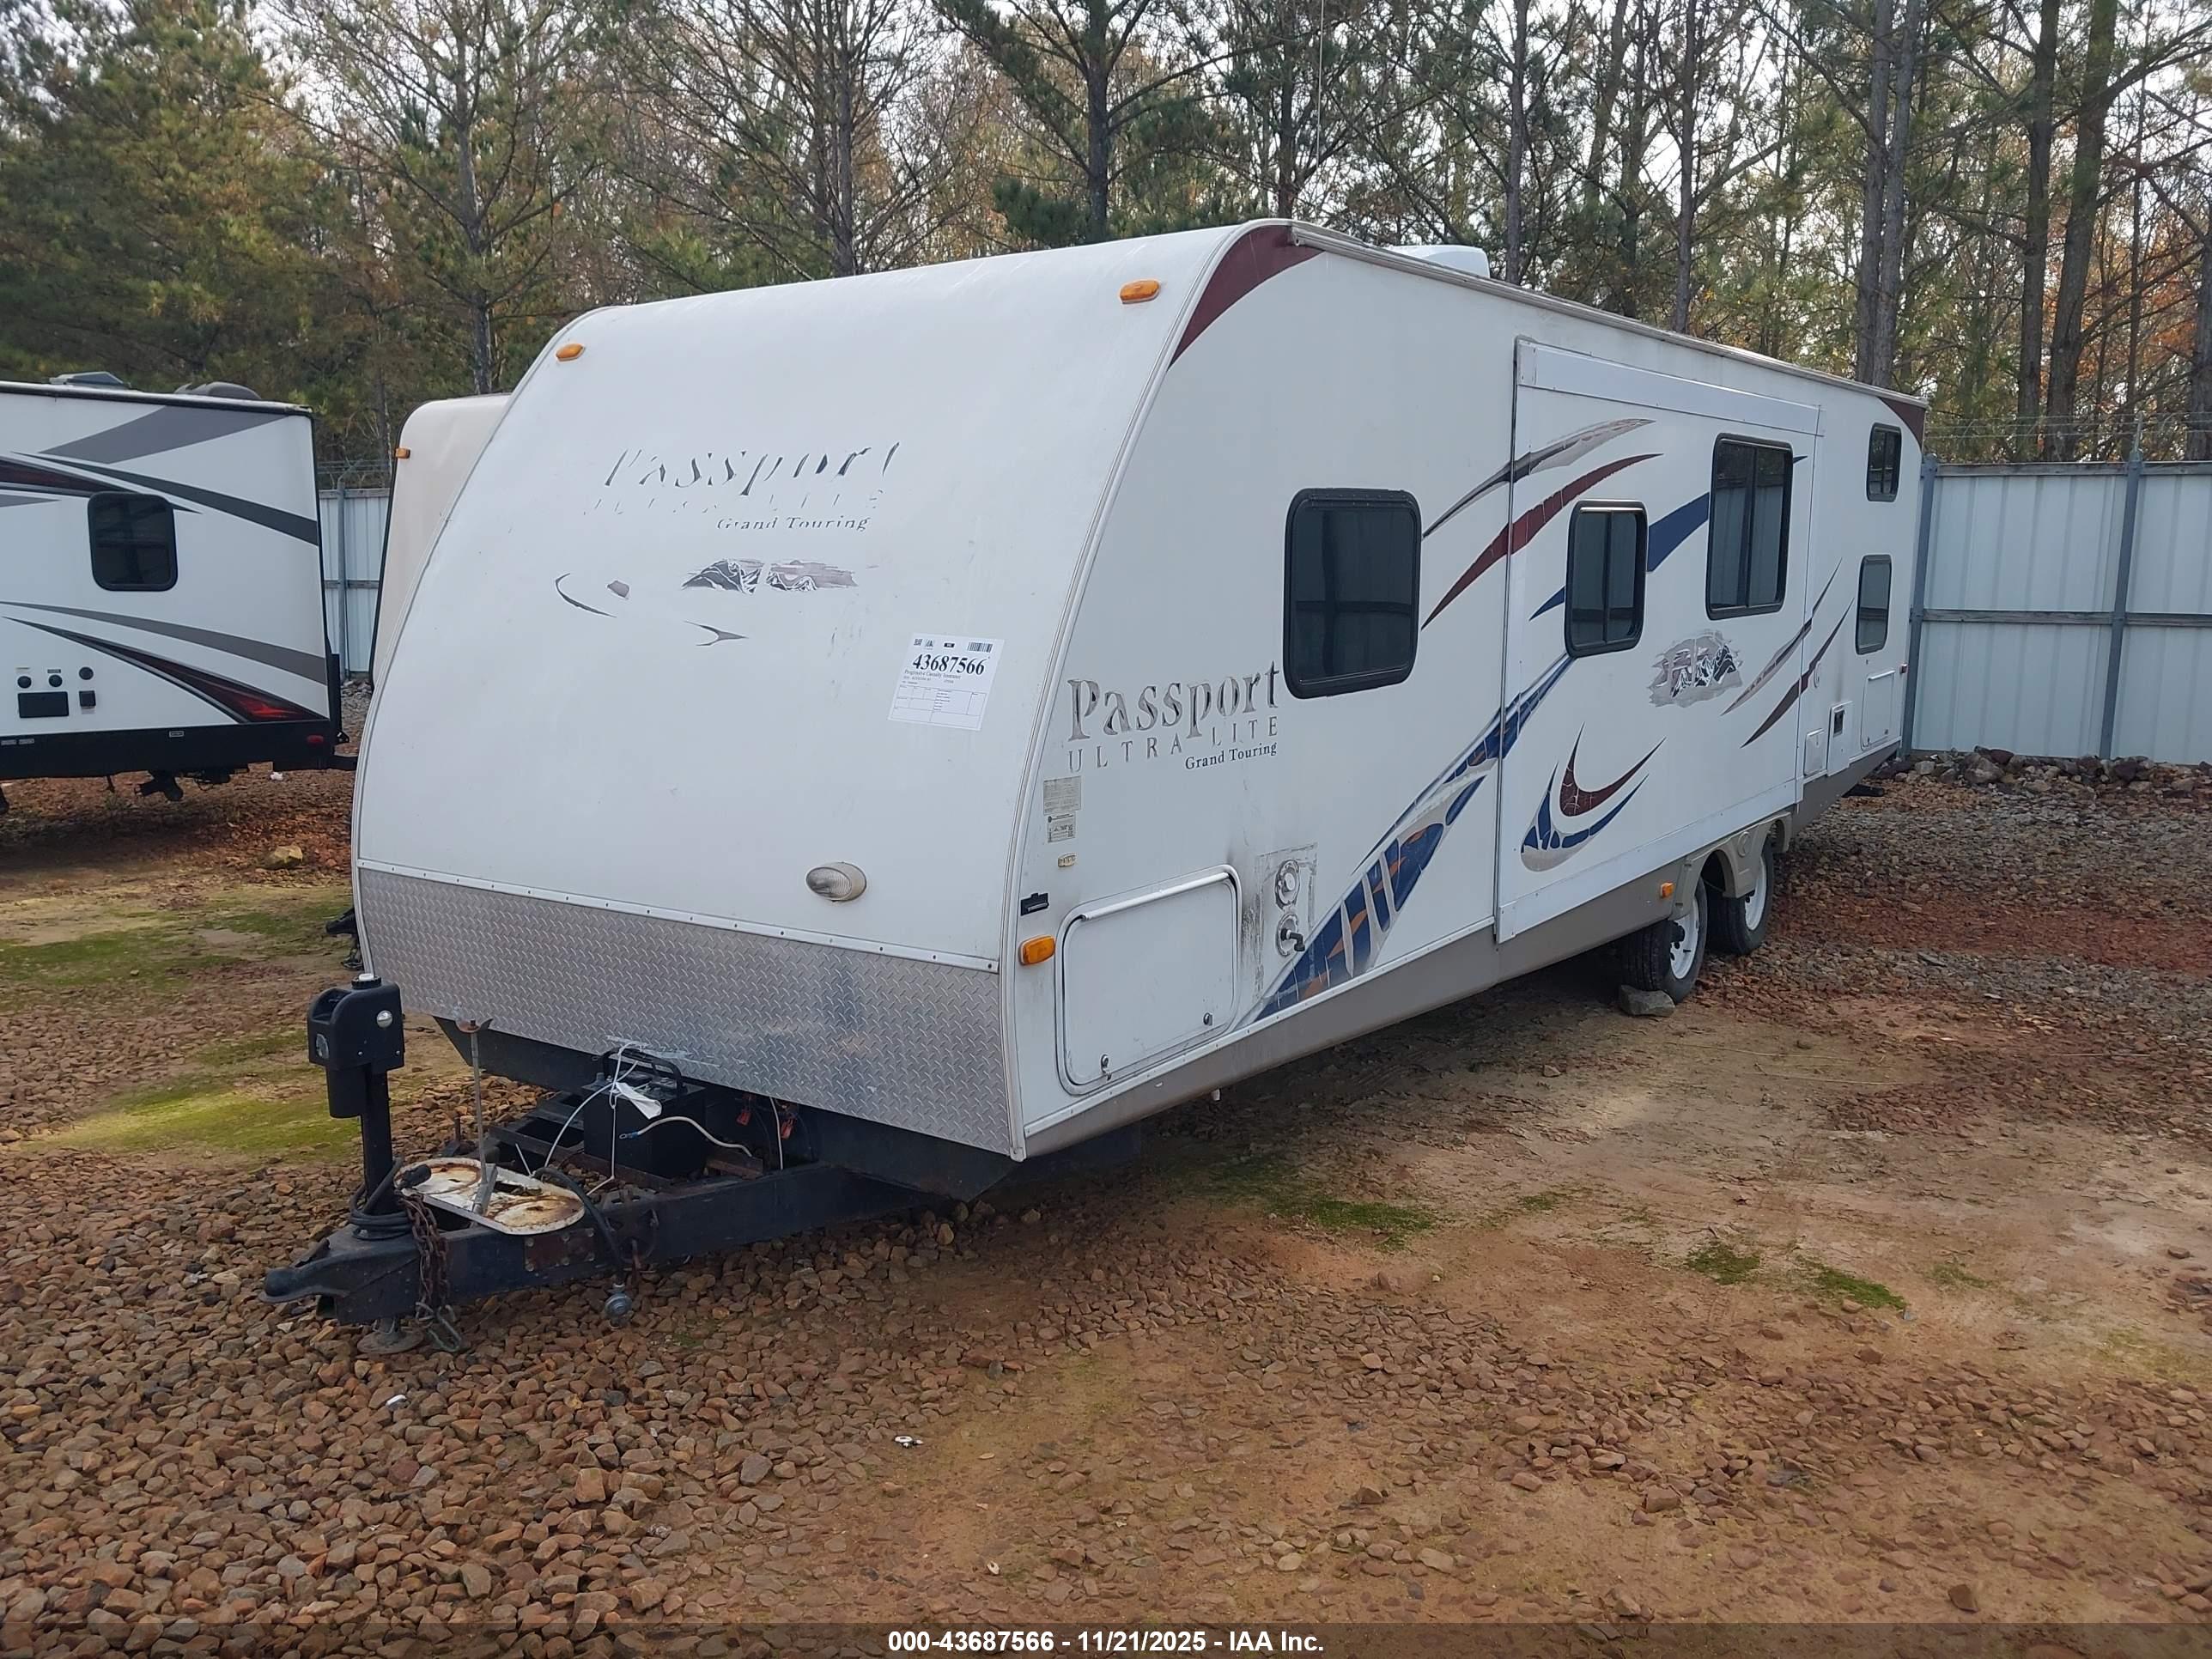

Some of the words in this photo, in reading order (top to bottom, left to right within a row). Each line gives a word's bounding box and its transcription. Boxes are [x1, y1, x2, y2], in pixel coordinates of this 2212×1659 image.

[786, 515, 871, 532] Touring
[912, 653, 988, 676] 43687566
[1067, 660, 1279, 742] Passport
[1068, 732, 1182, 773] ULTRA
[1212, 716, 1278, 747] LITE
[1185, 751, 1225, 770] Grand
[1229, 743, 1278, 762] Touring
